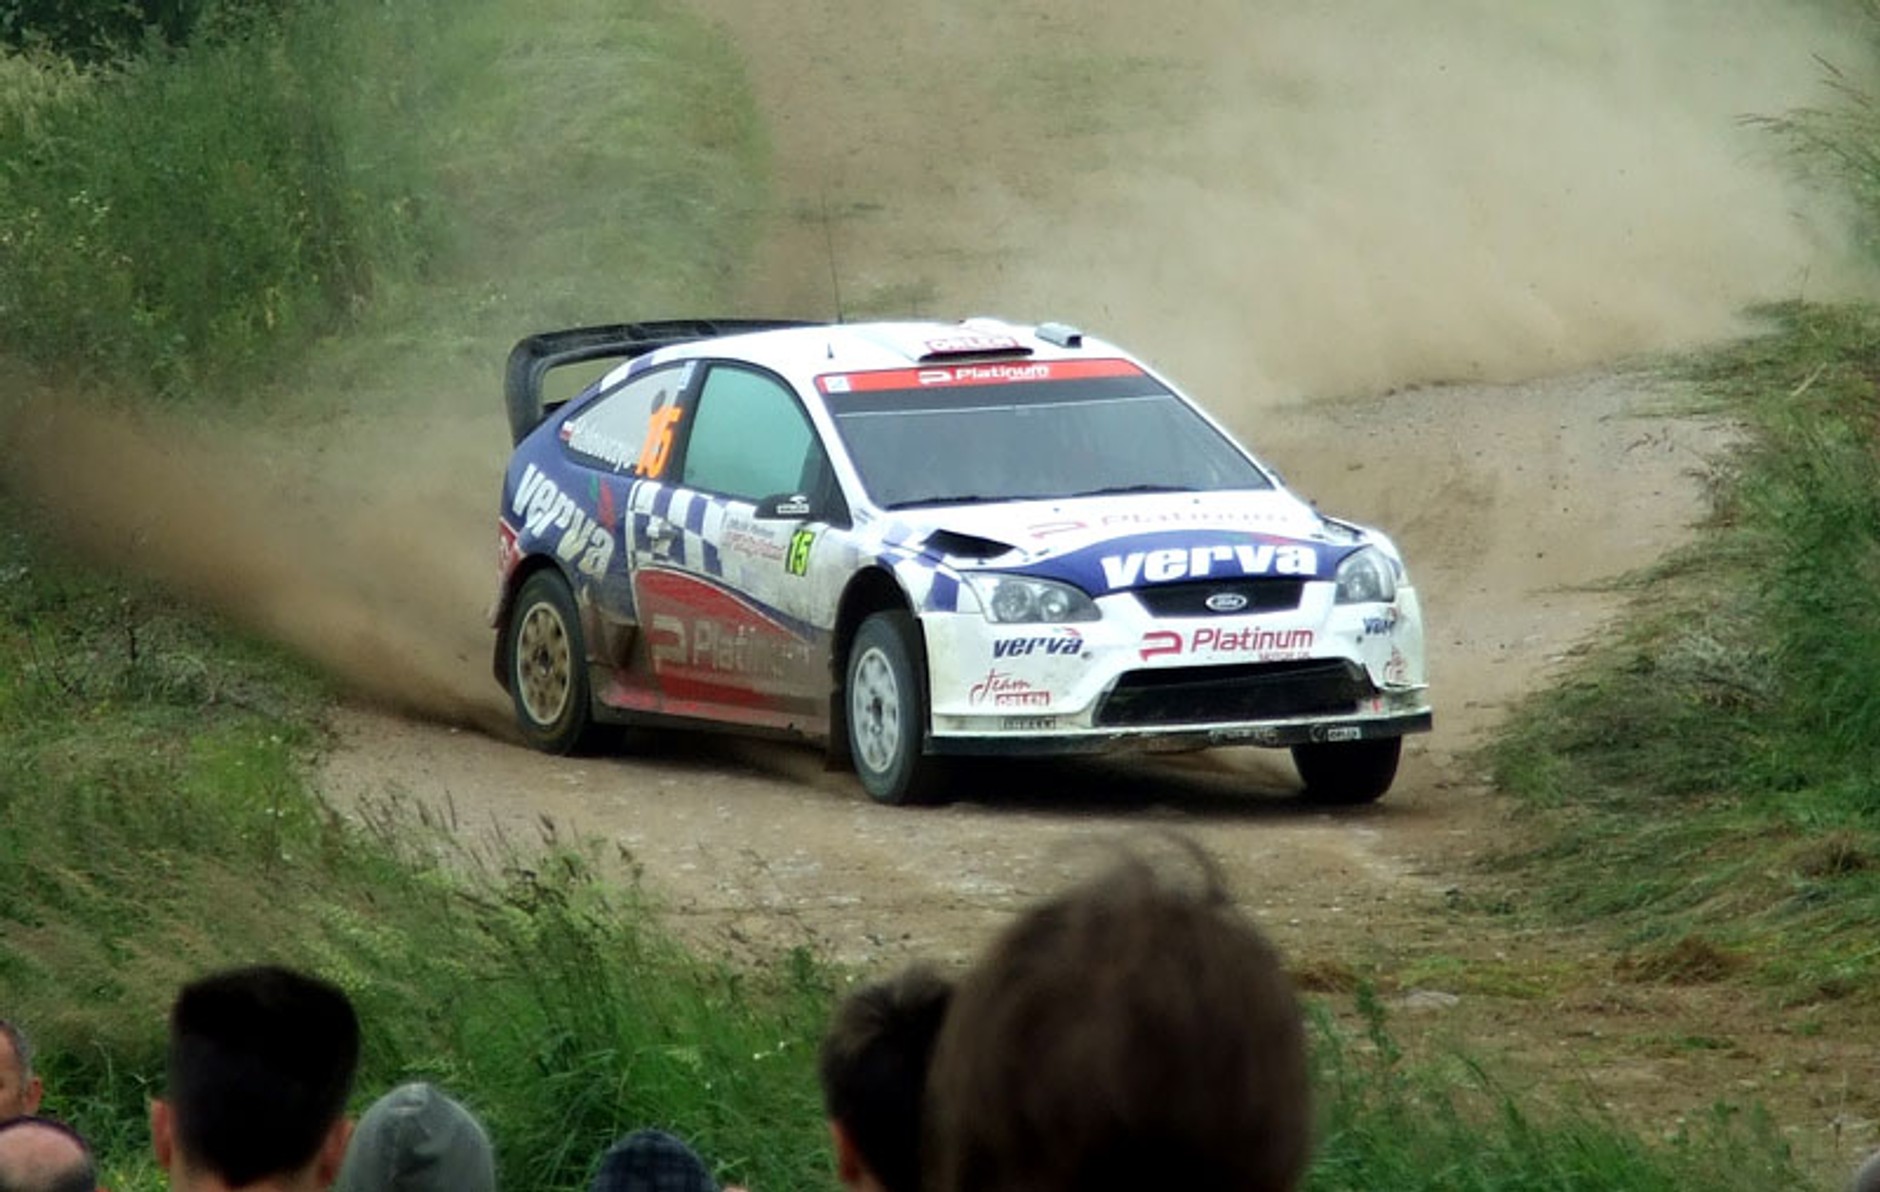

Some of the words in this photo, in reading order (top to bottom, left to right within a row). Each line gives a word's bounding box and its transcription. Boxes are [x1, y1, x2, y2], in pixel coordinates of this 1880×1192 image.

[955, 364, 1050, 381] Platinum
[512, 462, 615, 582] verva
[789, 530, 816, 577] 15
[1101, 543, 1318, 589] verva
[993, 636, 1084, 659] verva
[1190, 626, 1314, 652] Platinum
